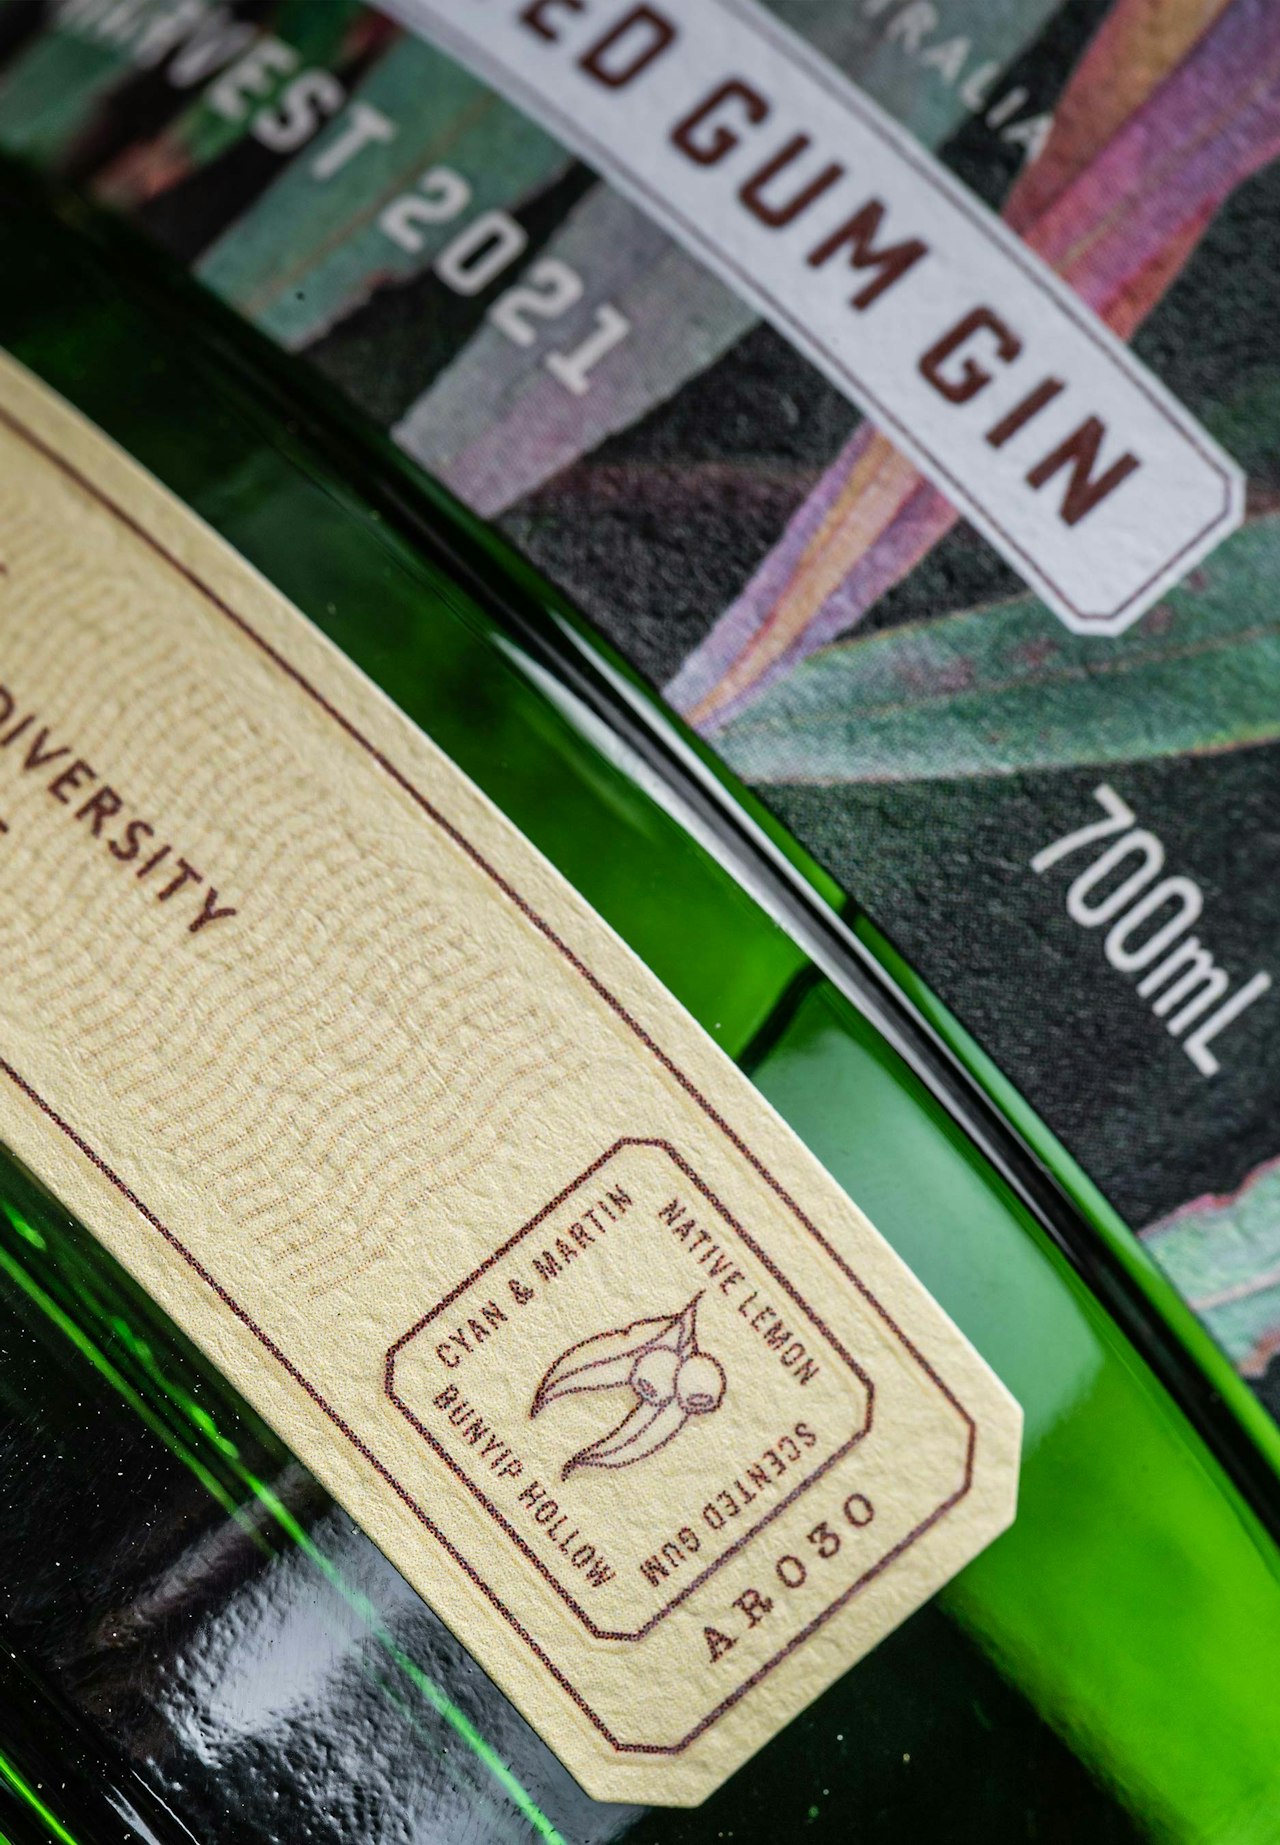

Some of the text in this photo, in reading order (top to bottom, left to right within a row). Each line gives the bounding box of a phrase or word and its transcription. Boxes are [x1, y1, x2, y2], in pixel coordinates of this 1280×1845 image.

[379, 166, 630, 396] 2021
[671, 78, 930, 314] GUM
[917, 304, 1141, 528] GIN
[1029, 783, 1271, 1077] 700mL
[435, 1183, 633, 1368] CYAN & MARTIN
[658, 1197, 821, 1387] NATIVE LEMON
[433, 1384, 617, 1588] BUNYIP HOLLOW
[640, 1422, 817, 1587] SCENTED GUM
